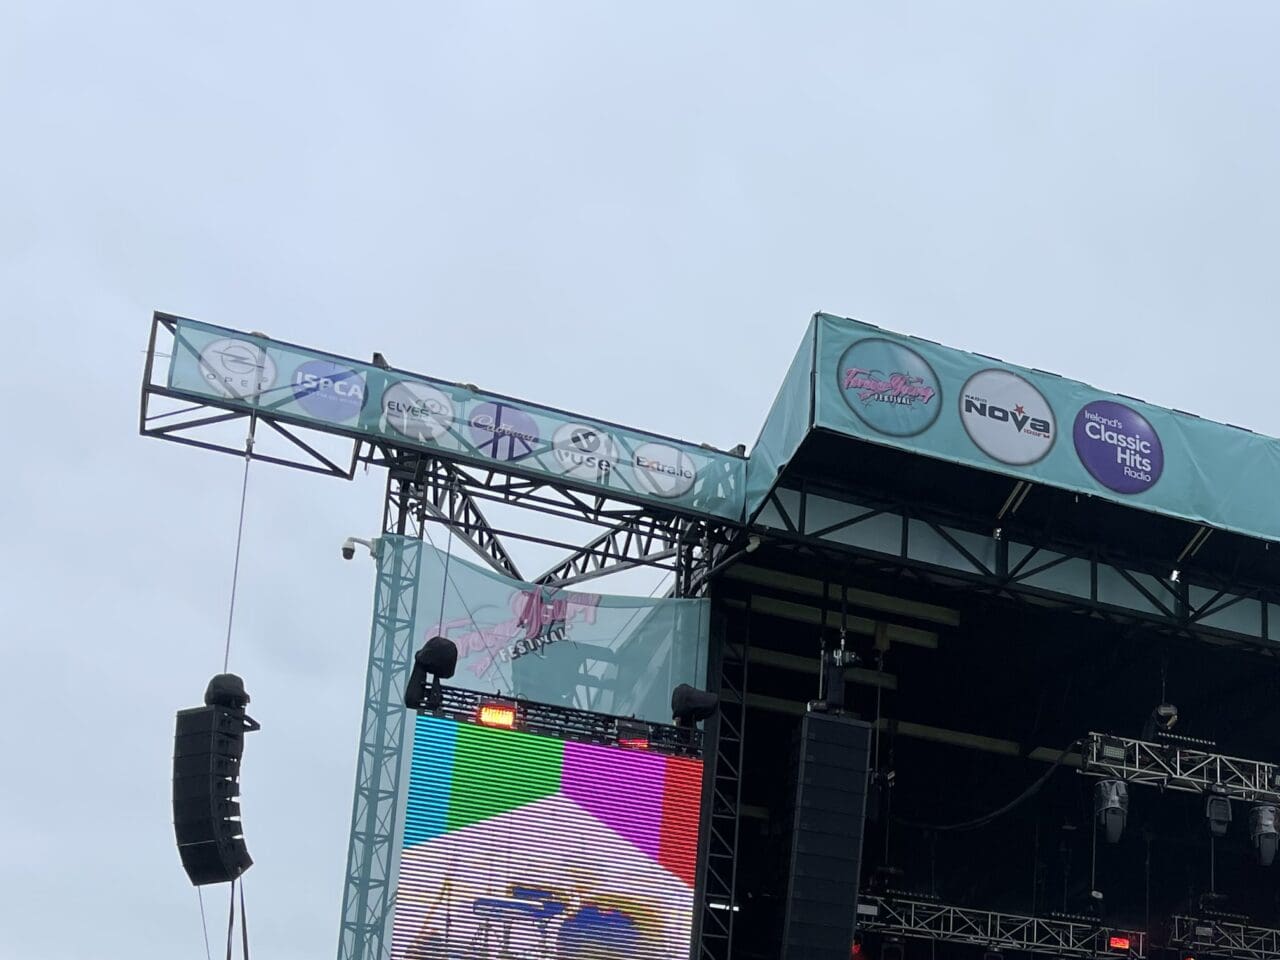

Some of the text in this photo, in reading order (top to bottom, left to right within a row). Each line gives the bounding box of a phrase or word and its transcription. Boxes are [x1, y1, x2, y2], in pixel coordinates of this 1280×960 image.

[296, 371, 363, 400] ISPCA
[387, 400, 430, 417] ELVES
[1085, 409, 1122, 429] Ireland's
[1085, 421, 1151, 454] Classic
[1117, 446, 1152, 472] Hits
[1123, 466, 1152, 482] Radio
